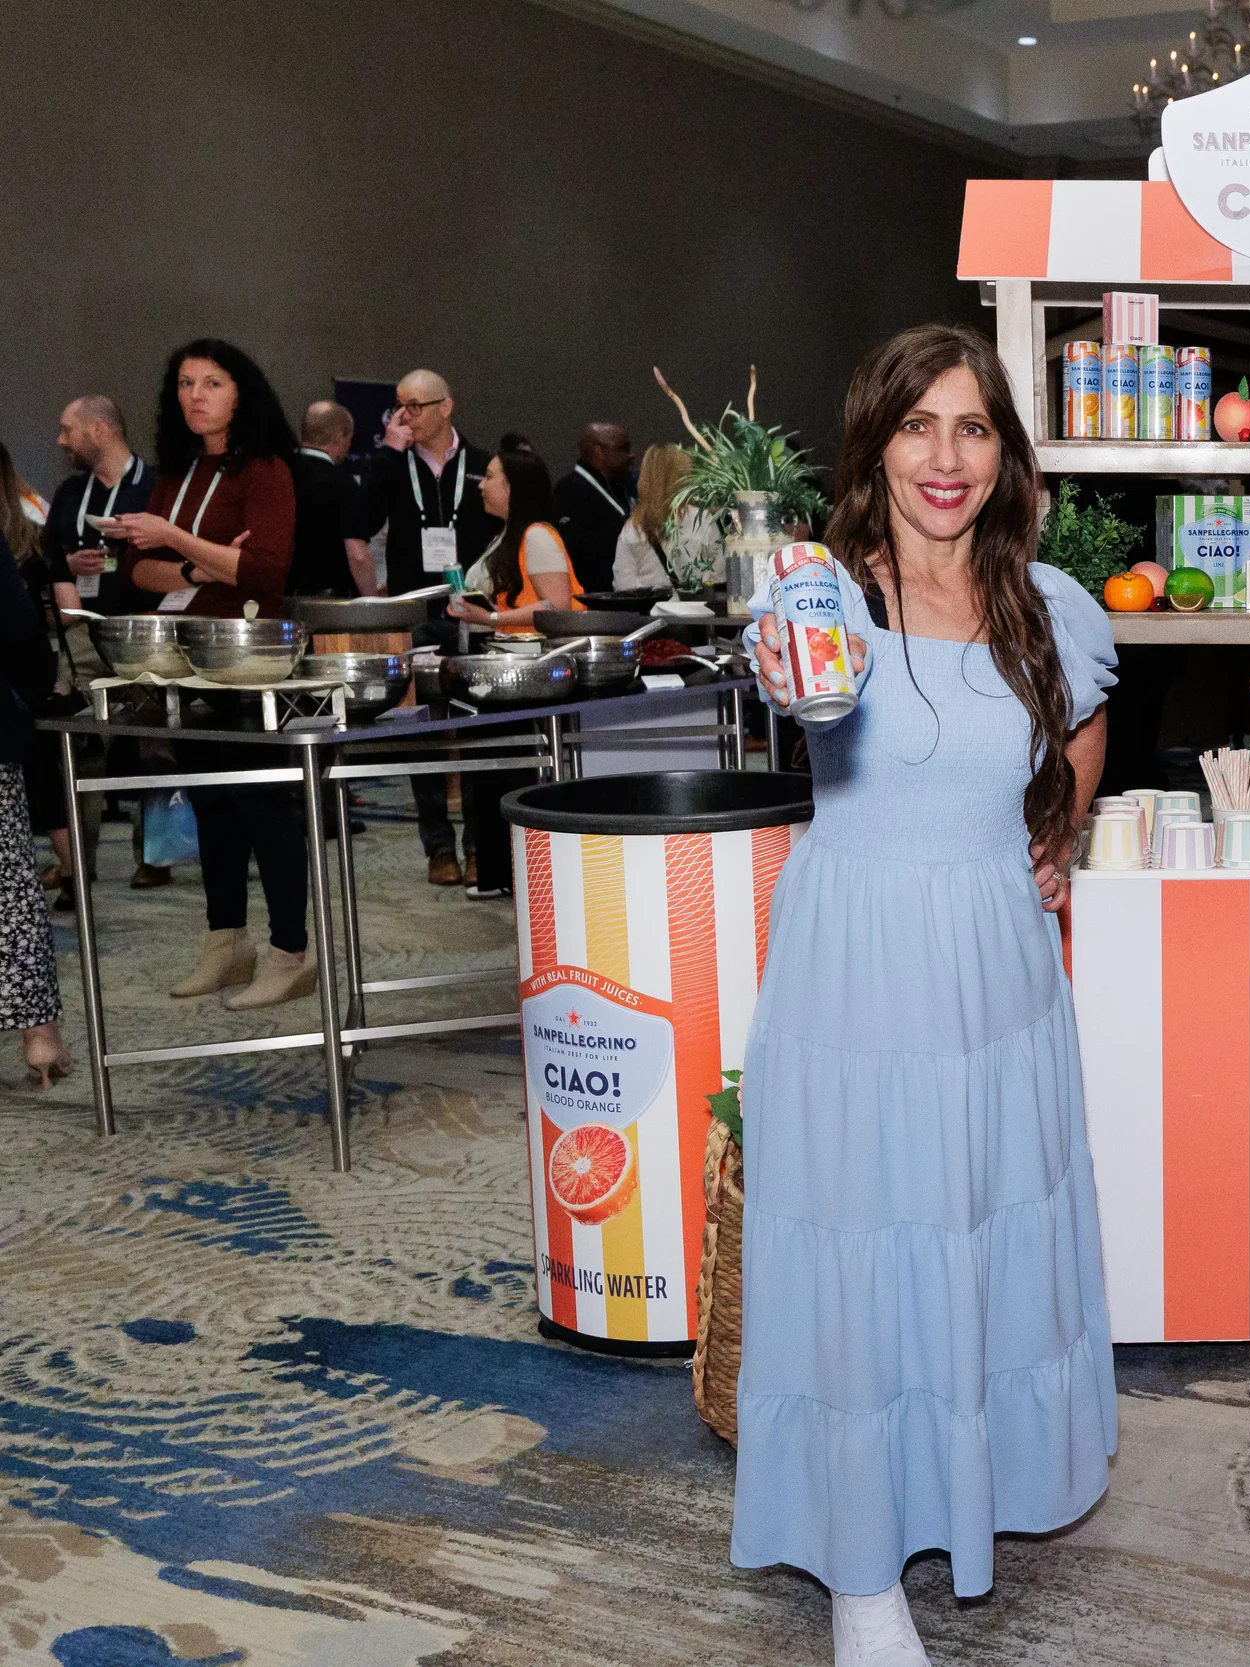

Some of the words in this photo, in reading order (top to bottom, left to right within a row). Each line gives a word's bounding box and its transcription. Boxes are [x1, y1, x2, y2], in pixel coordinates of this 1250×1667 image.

[1148, 381, 1173, 389] CAO!
[1184, 382, 1209, 390] CAO!
[1197, 545, 1240, 557] CIAO!
[784, 581, 840, 593] SANPELLEGR
[796, 597, 840, 612] CIAO!
[530, 975, 547, 991] WITH
[547, 970, 568, 982] REAL
[569, 970, 599, 987] FRUIT
[600, 981, 639, 1006] JUICES
[555, 1015, 566, 1023] DAL
[533, 1024, 637, 1051] SANPELLEGRINO
[544, 1045, 565, 1055] ITALIAN
[544, 1062, 621, 1098] CIAO!
[546, 1092, 575, 1107] BLOOD
[577, 1099, 622, 1113] ORANGE
[541, 1253, 603, 1295] SPARKLING
[607, 1273, 667, 1298] WATER
